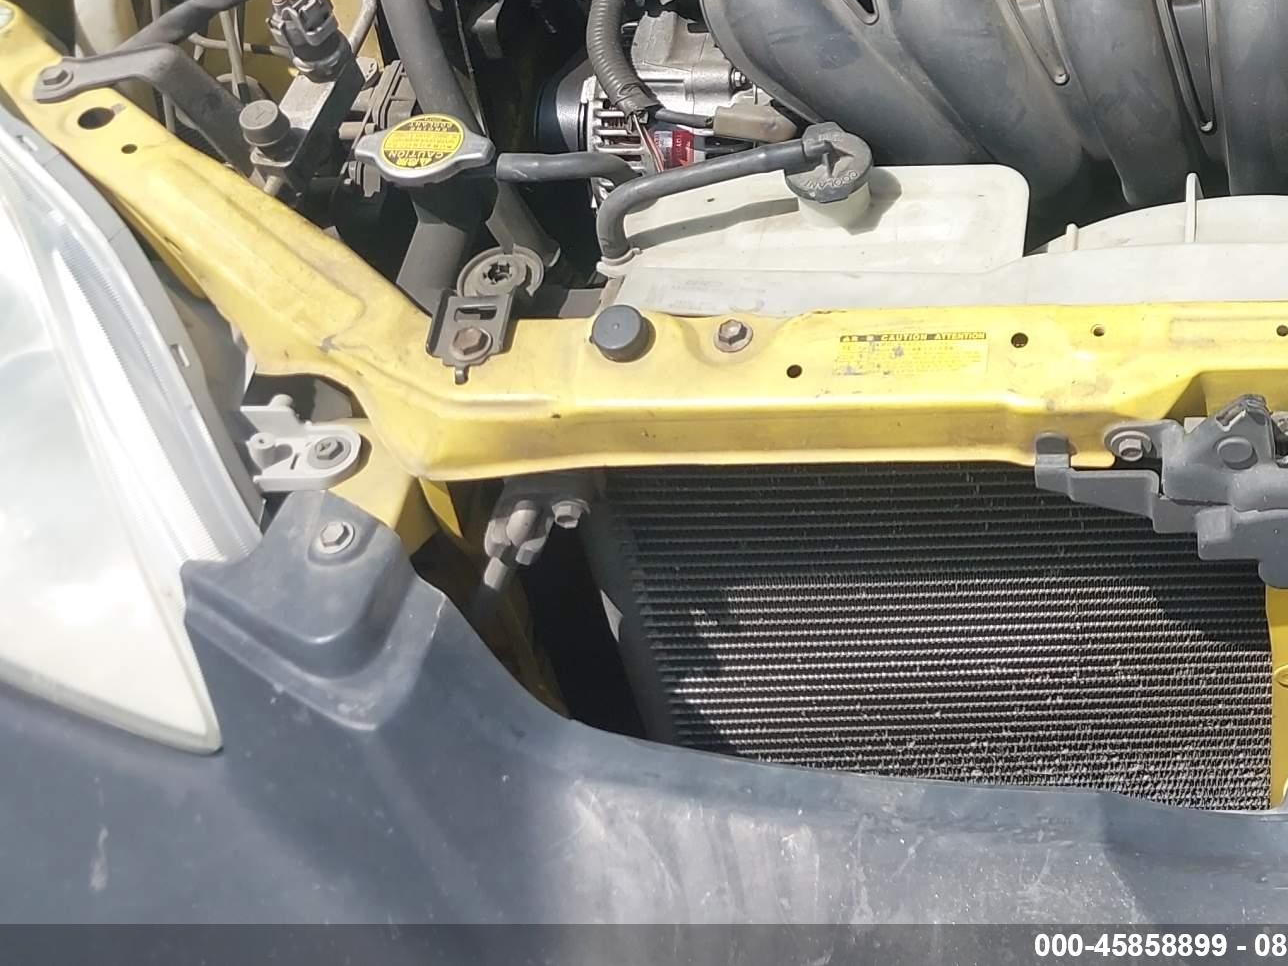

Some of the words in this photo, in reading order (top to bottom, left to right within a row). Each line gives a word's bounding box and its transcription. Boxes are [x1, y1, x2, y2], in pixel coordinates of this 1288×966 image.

[388, 150, 444, 159] CAUTION
[880, 333, 928, 342] CAUTION
[934, 332, 985, 341] ATTENTION
